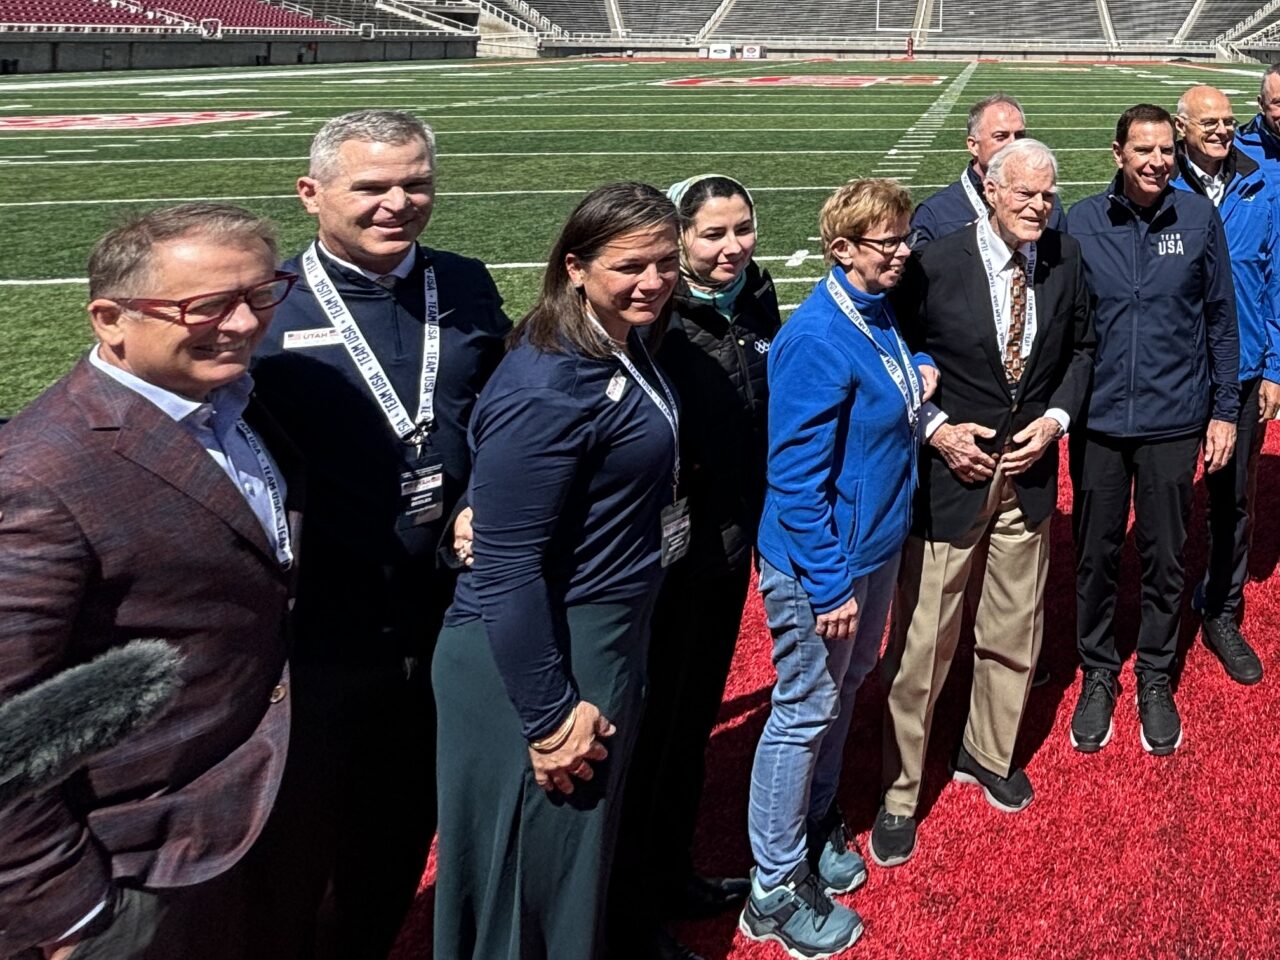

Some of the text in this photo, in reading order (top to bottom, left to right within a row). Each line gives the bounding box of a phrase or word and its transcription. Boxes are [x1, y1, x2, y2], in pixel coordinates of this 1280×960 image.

[1158, 240, 1184, 255] USA
[305, 255, 318, 274] TEAM
[314, 278, 333, 298] USA
[427, 275, 436, 291] USA
[324, 296, 346, 320] TEAM
[428, 301, 438, 322] TEAM
[847, 308, 860, 322] USA
[303, 332, 328, 340] UTAH
[341, 324, 359, 345] USA
[428, 323, 438, 340] USA
[350, 343, 373, 367] TEAM
[424, 351, 438, 373] TEAM
[368, 371, 388, 392] USA
[423, 375, 435, 394] USA
[379, 389, 399, 413] TEAM
[263, 465, 277, 491] TEAM
[271, 493, 280, 513] USA
